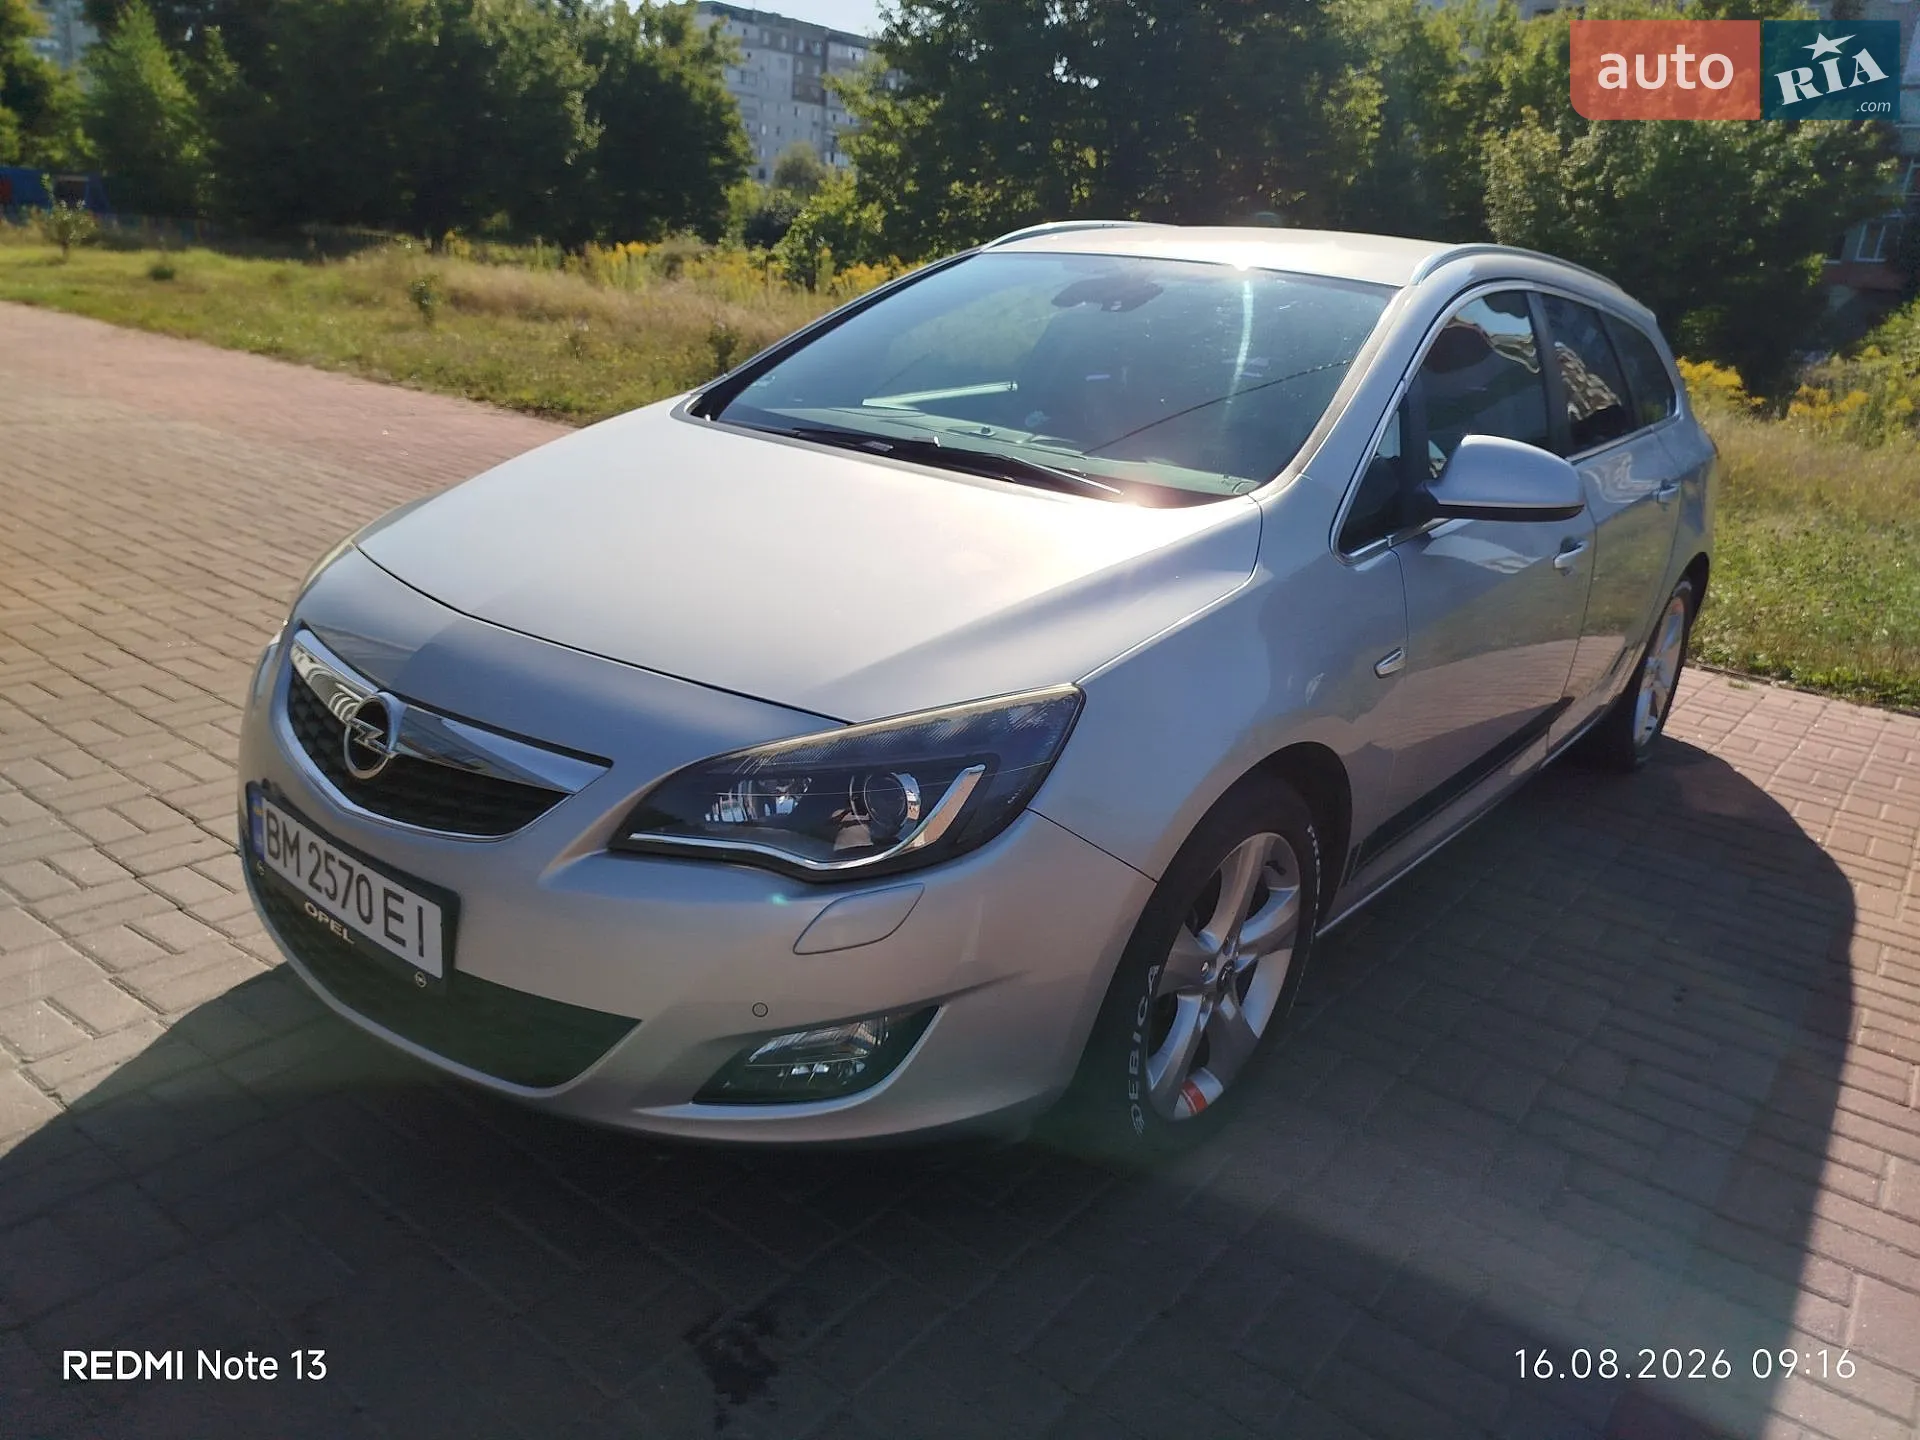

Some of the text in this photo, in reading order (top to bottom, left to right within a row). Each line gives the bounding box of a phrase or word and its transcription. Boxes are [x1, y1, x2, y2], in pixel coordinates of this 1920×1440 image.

[265, 808, 425, 958] BM 2570 EI
[304, 901, 355, 945] OPEL
